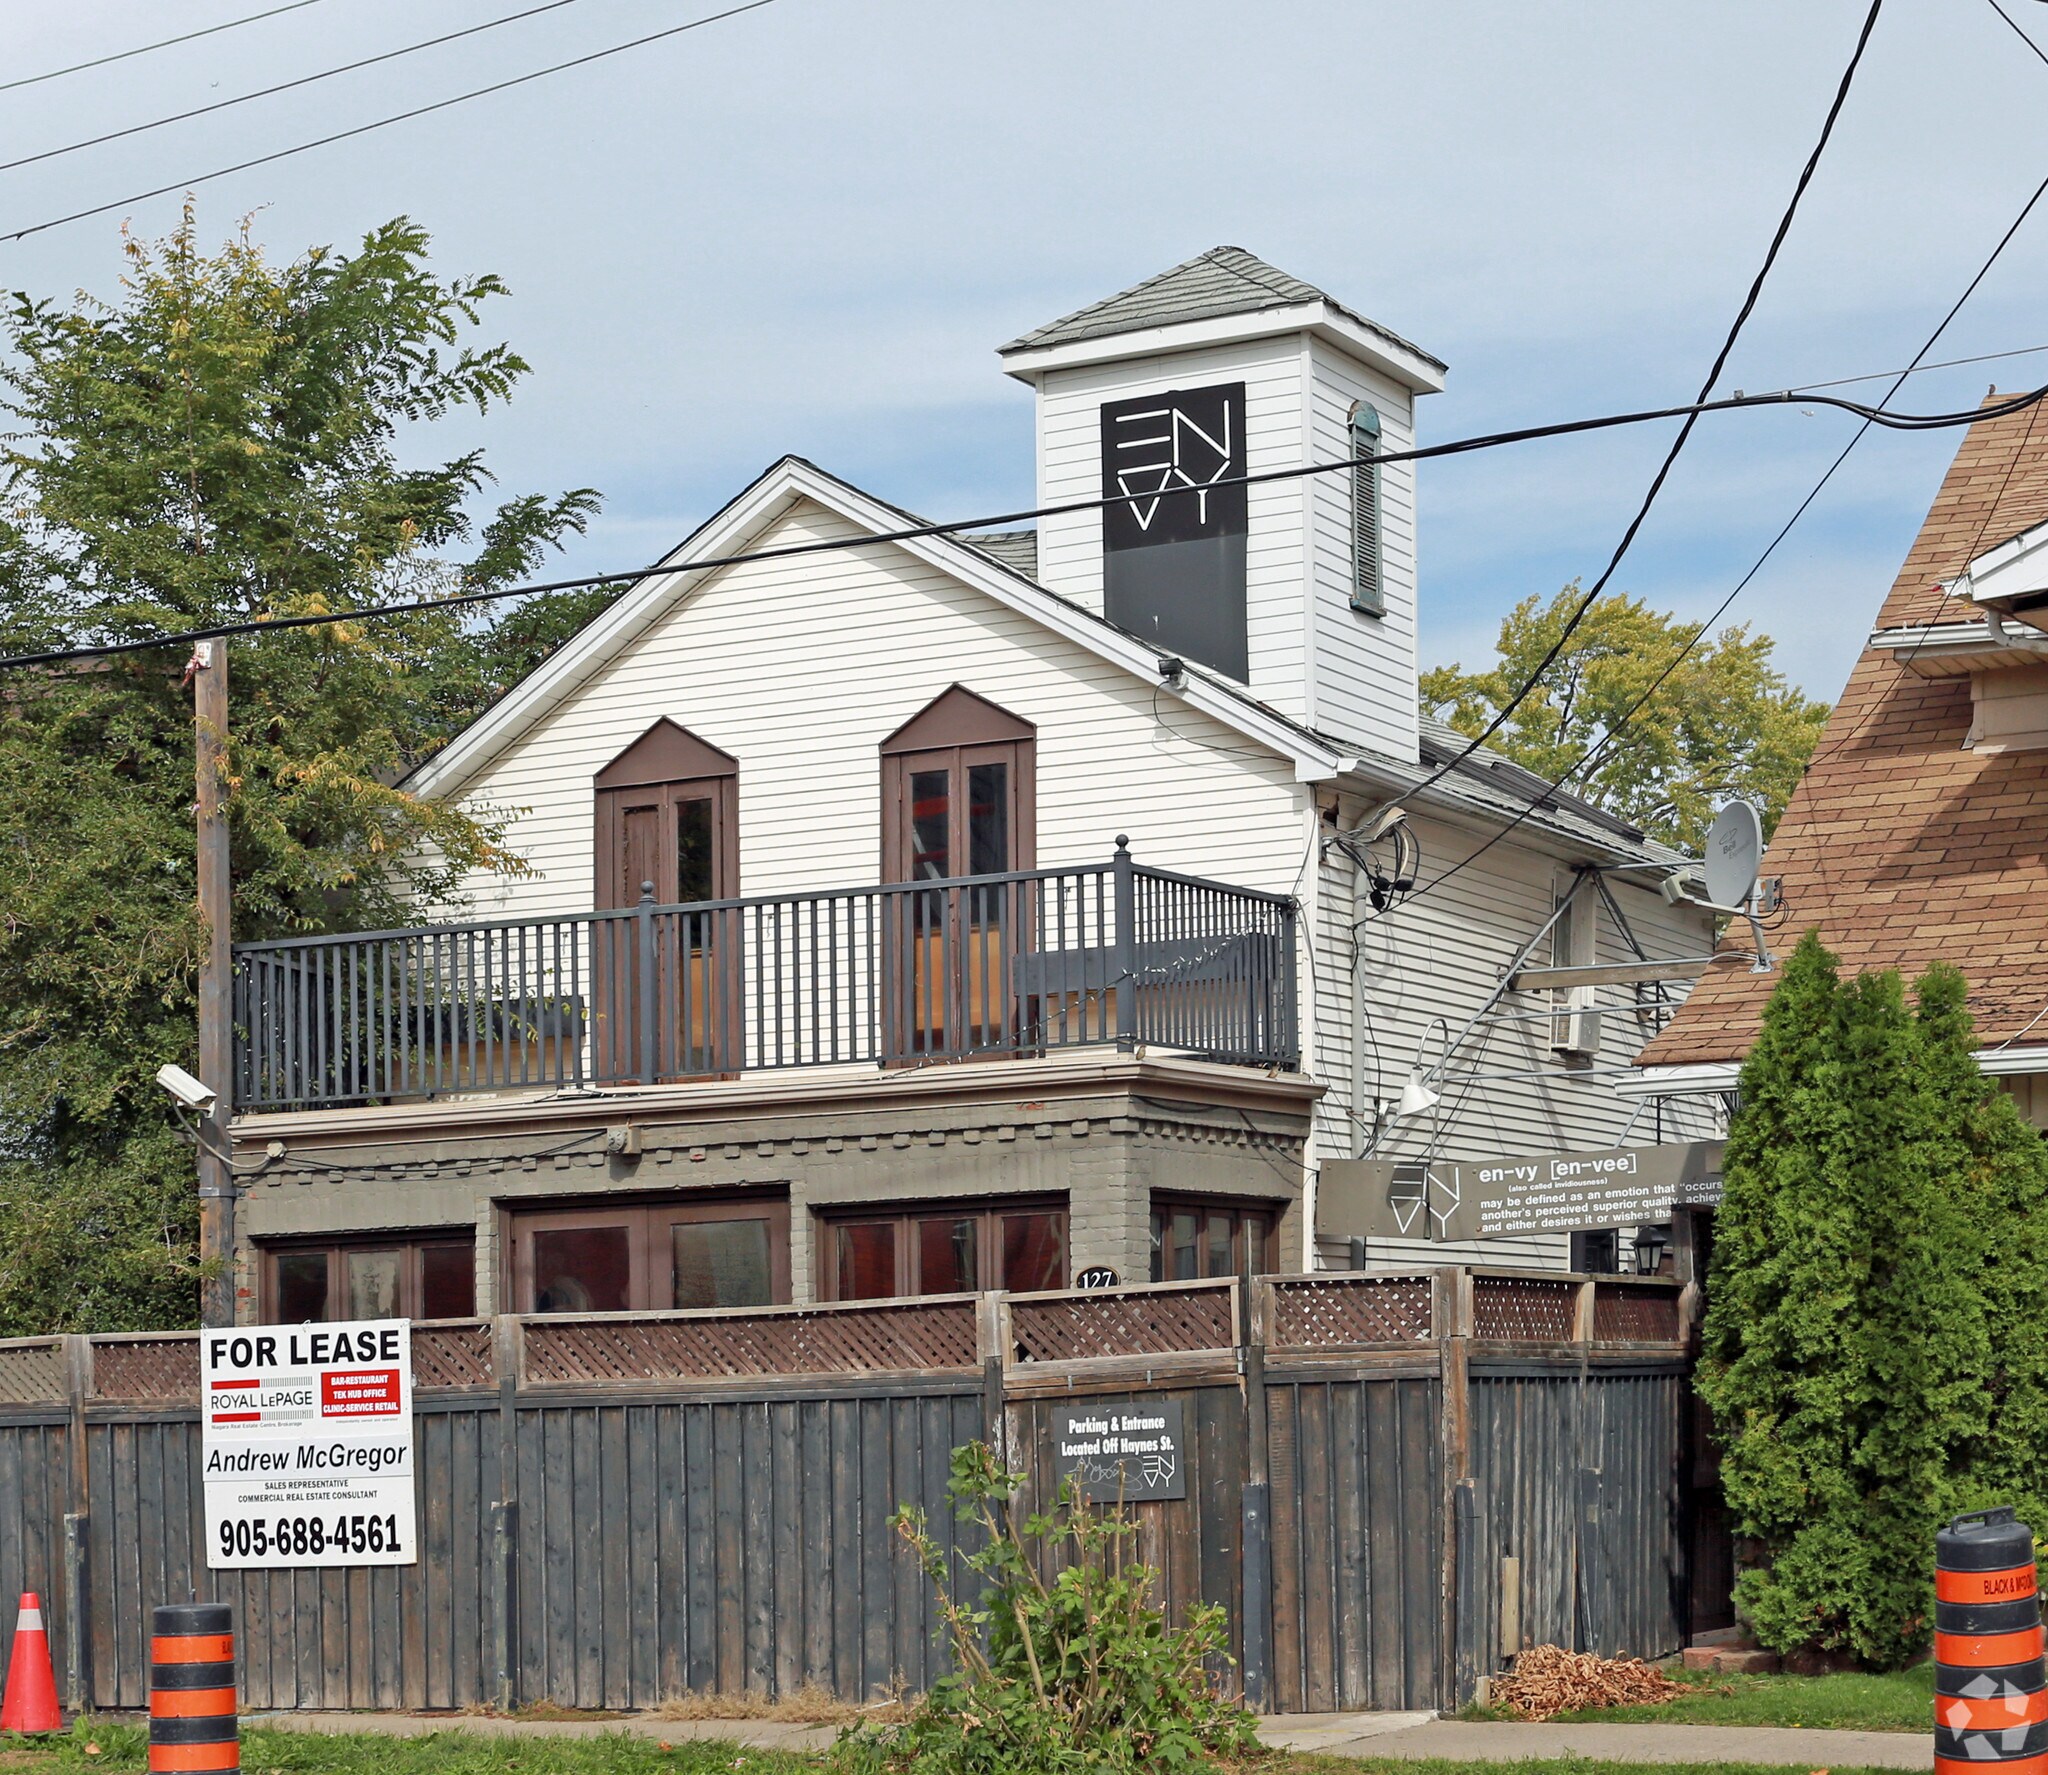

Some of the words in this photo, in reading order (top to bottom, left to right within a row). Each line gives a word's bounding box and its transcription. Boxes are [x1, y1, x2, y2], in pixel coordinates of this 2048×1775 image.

[1479, 1165, 1538, 1182] en-vy
[1550, 1153, 1637, 1180] [en-vee]
[1480, 1199, 1503, 1210] may
[1507, 1197, 1521, 1207] be
[1525, 1192, 1566, 1205] defined
[1570, 1193, 1583, 1201] as
[1587, 1190, 1601, 1199] an
[1605, 1186, 1650, 1199] emotion
[1653, 1184, 1676, 1195] that
[1508, 1185, 1527, 1193] (also
[1529, 1182, 1553, 1191] called
[1481, 1207, 1531, 1221] another's
[1535, 1202, 1589, 1218] perceived
[1593, 1199, 1638, 1213] superior
[1481, 1221, 1502, 1233] and
[1506, 1219, 1537, 1231] either
[1541, 1217, 1581, 1228] desires
[1585, 1215, 1593, 1224] it
[1597, 1214, 1609, 1223] or
[1613, 1210, 1650, 1222] wishes
[1655, 1208, 1672, 1219] tha
[1082, 1271, 1113, 1290] 127
[211, 1337, 278, 1369] FOR
[290, 1330, 400, 1366] LEASE
[331, 1374, 389, 1386] BAR-RESTAURANT
[211, 1393, 258, 1410] ROYAL
[347, 1389, 362, 1399] HUB
[363, 1388, 387, 1398] OFFICE
[323, 1402, 374, 1413] CLINIC-SERVICE
[374, 1401, 399, 1412] RETAIL
[1068, 1417, 1108, 1436] Parking
[1110, 1416, 1120, 1432] &
[1121, 1416, 1166, 1431] Entrance
[1061, 1438, 1101, 1456] Located
[1102, 1437, 1119, 1454] Off
[1120, 1438, 1158, 1456] Haynes
[1160, 1435, 1175, 1451] St.
[207, 1448, 290, 1473] Andrew
[296, 1443, 407, 1472] McGregor
[264, 1481, 287, 1490] SALES
[288, 1479, 349, 1489] REPRESENTATIVE
[238, 1493, 285, 1502] COMMERCIAL
[286, 1493, 305, 1501] REAL
[306, 1491, 331, 1500] ESTATE
[332, 1490, 378, 1499] CONSULTANT
[219, 1514, 402, 1557] 905-688-4561
[1984, 1578, 2009, 1595] BLACK
[2010, 1577, 2015, 1593] &
